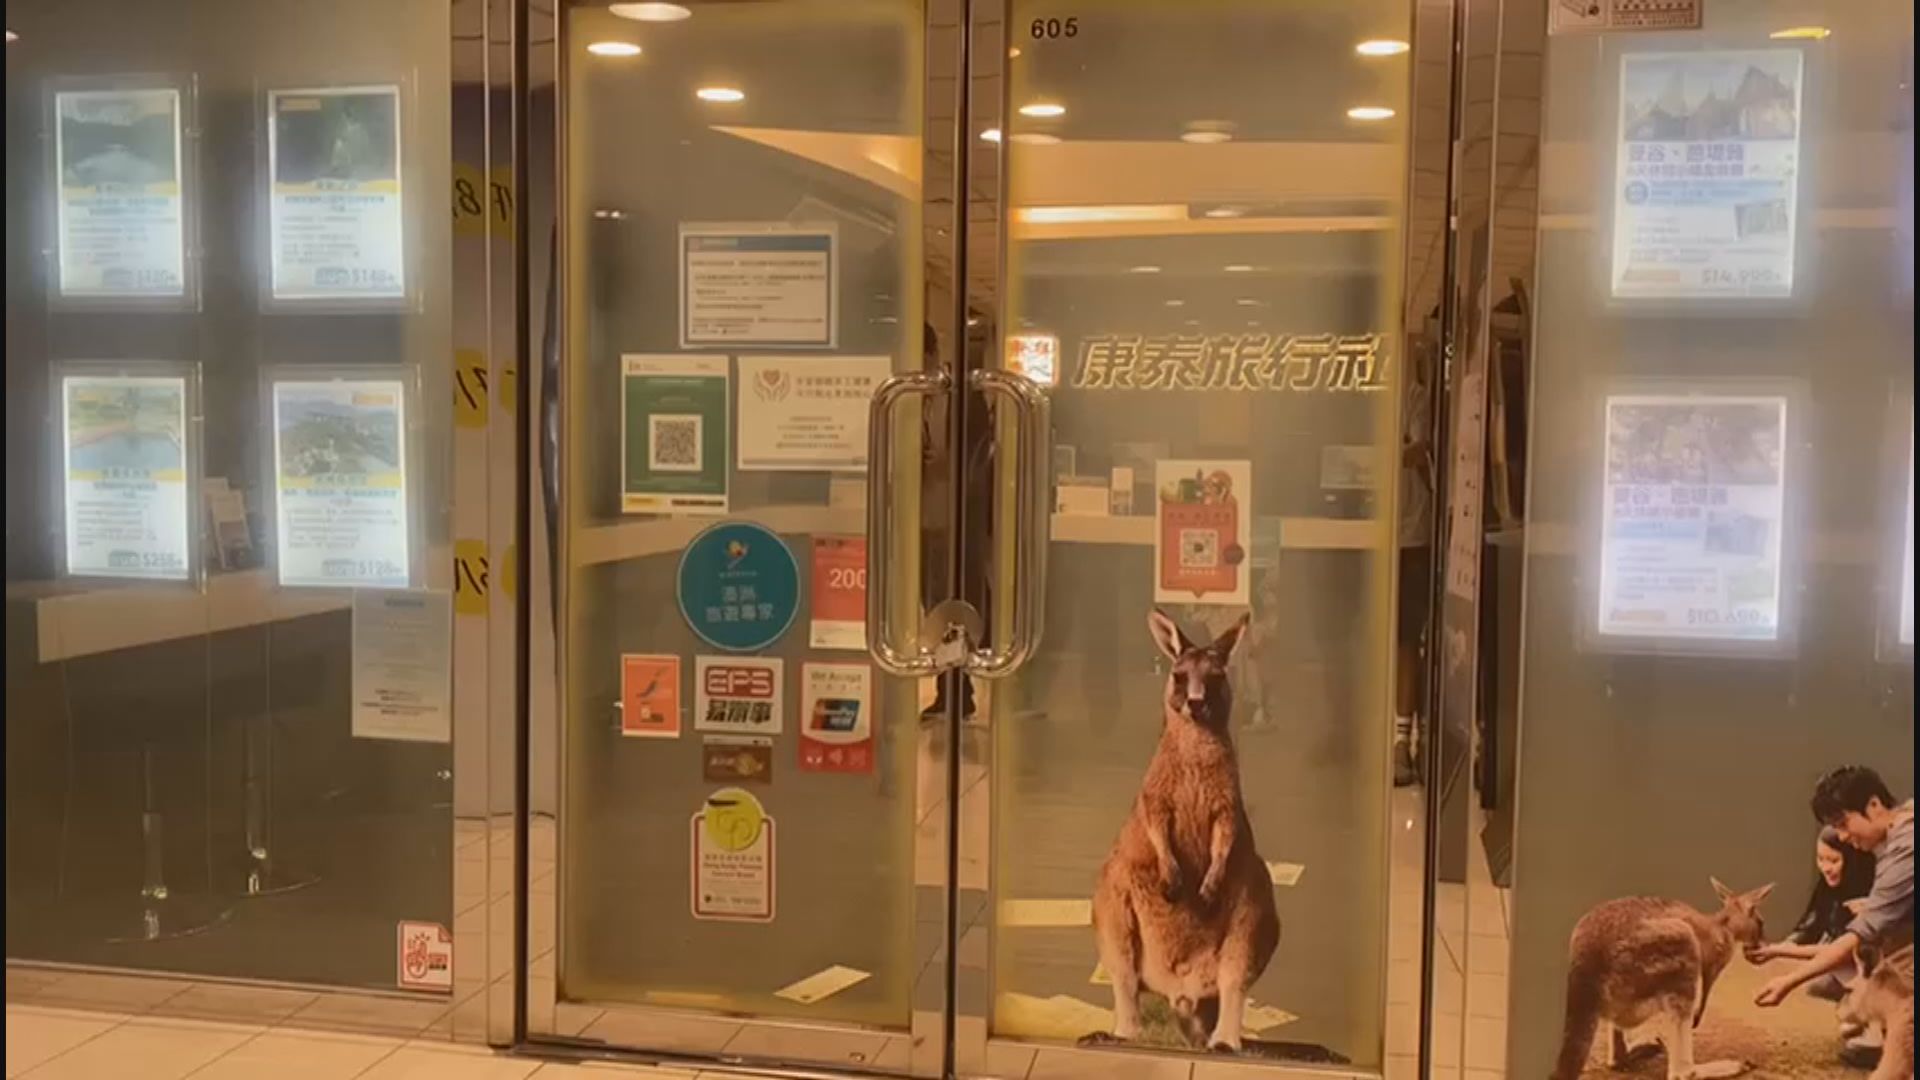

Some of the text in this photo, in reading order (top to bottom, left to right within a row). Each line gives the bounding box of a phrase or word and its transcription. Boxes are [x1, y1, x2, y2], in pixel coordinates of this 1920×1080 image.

[1031, 18, 1079, 39] 605
[1073, 334, 1391, 391] 康泰旅行社
[706, 668, 772, 696] EPS
